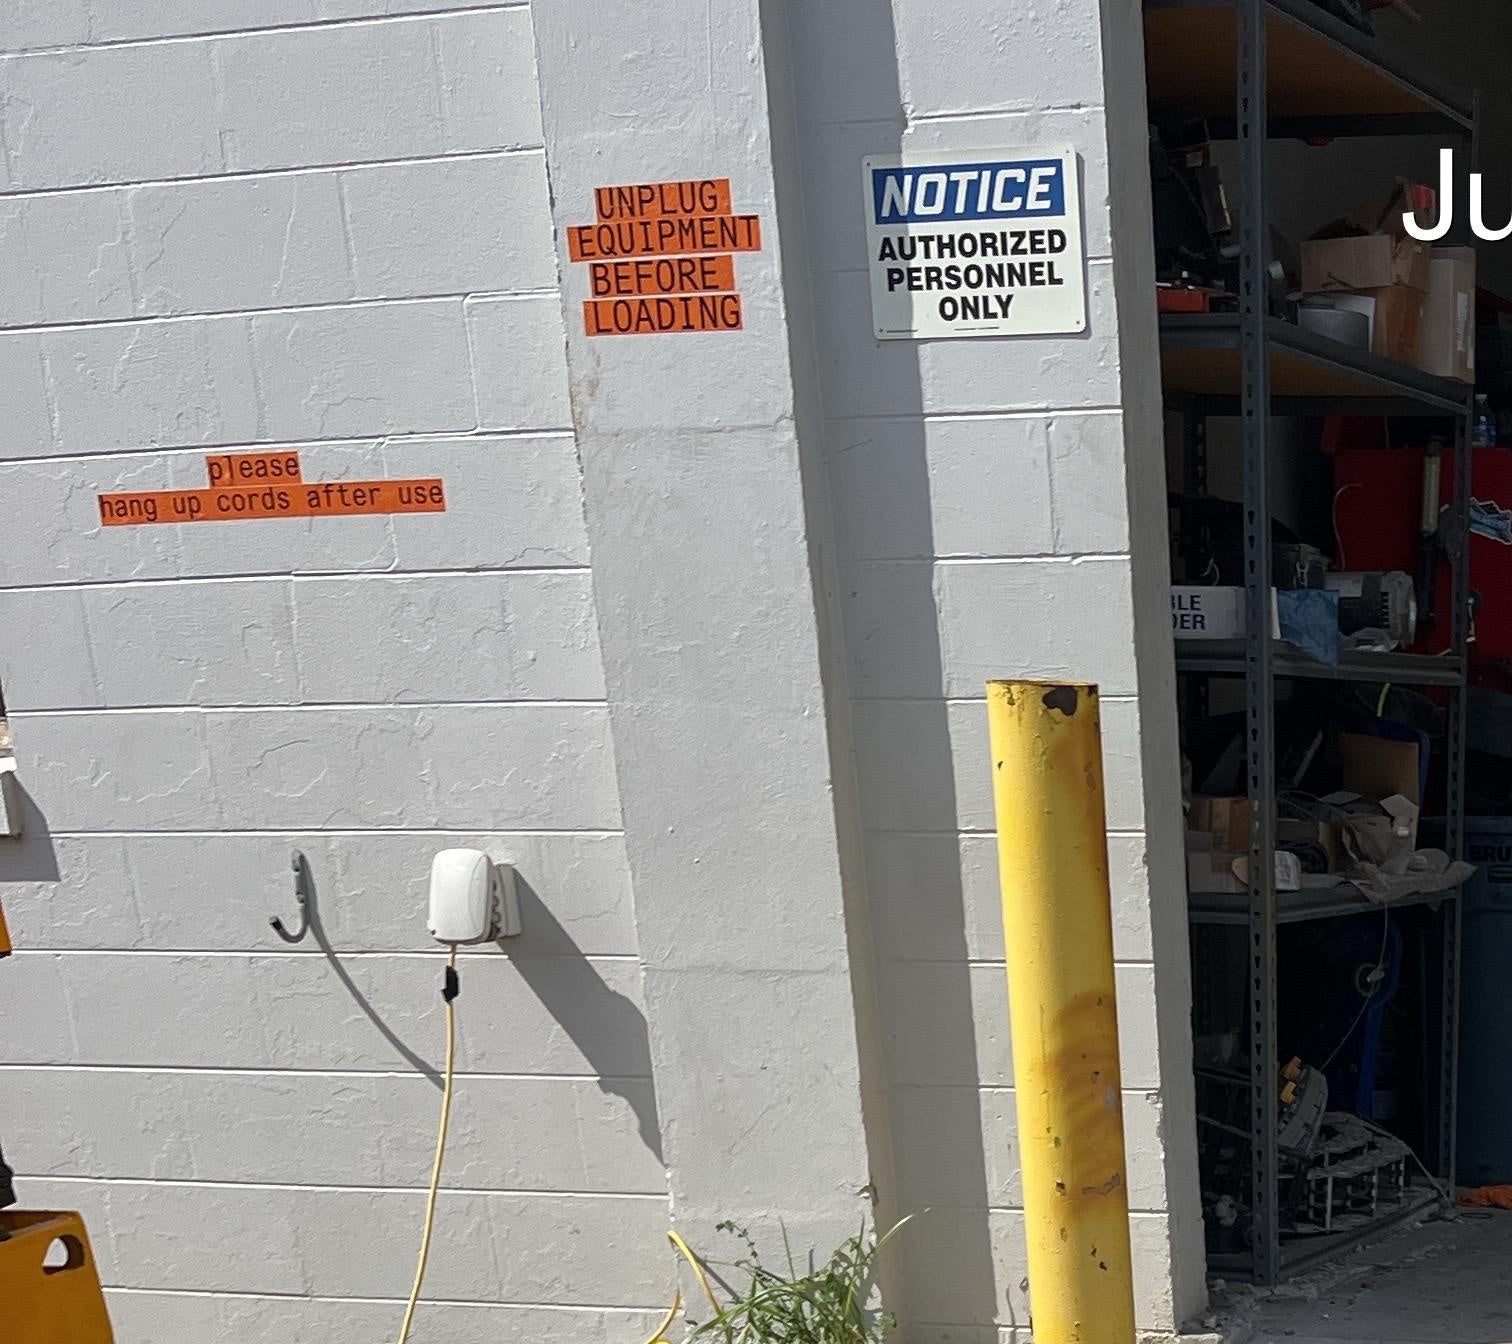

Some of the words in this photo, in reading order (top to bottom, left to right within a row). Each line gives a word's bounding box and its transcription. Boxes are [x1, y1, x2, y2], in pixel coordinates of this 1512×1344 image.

[596, 180, 718, 220] UNPLUG
[881, 166, 1058, 218] NOTICE
[578, 214, 759, 258] EQUIPMENT
[877, 229, 1068, 262] AUTHORIZED
[591, 256, 719, 296] BEFORE
[886, 260, 1064, 292] PERSONNEL
[592, 294, 740, 334] LOADING
[939, 294, 1014, 322] ONLY
[209, 455, 300, 486] please
[99, 494, 158, 522] hang
[172, 494, 201, 520] up
[216, 487, 291, 513] cords
[307, 484, 381, 508] after
[398, 484, 444, 505] use
